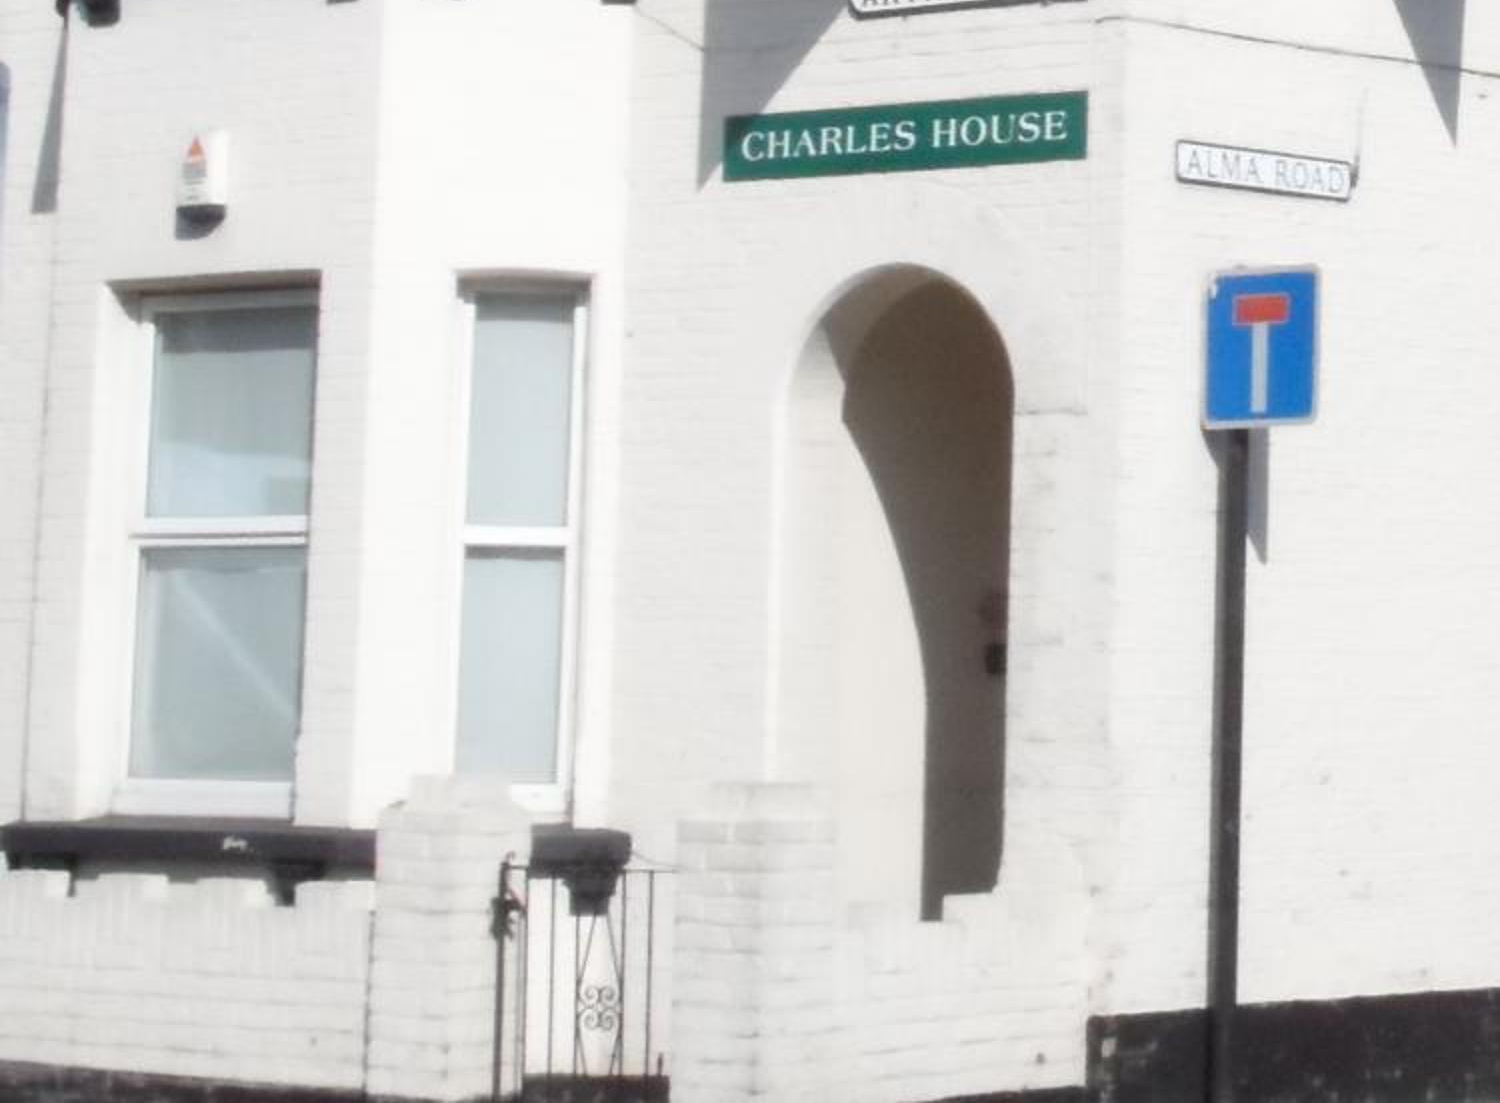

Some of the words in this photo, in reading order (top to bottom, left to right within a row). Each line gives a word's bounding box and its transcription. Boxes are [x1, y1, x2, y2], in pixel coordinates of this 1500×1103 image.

[741, 120, 917, 162] CHARLES
[931, 110, 1069, 149] HOUSE
[1186, 148, 1261, 183] ALMA
[1274, 159, 1346, 193] ROAD
